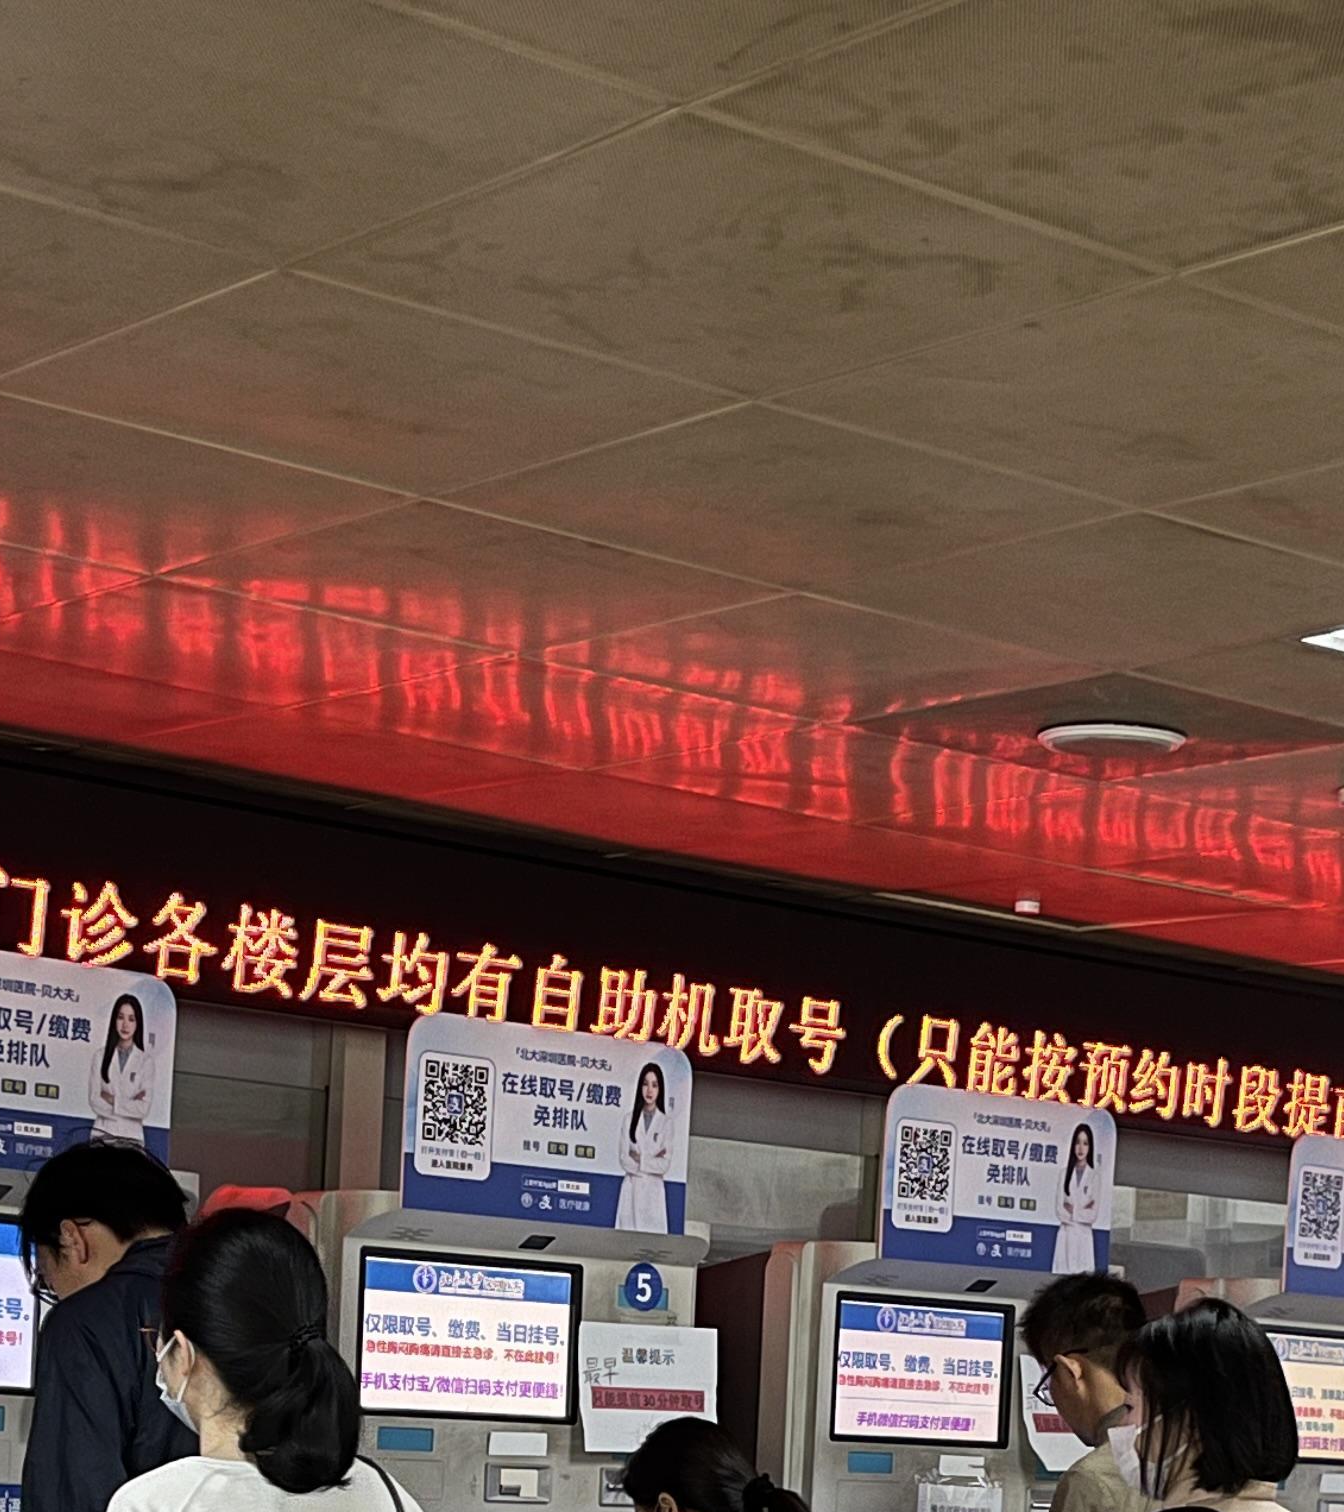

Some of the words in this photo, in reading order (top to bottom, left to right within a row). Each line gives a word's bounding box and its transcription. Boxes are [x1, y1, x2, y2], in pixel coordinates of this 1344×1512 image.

[501, 1072, 622, 1108] 在线取号/缴费
[533, 1104, 588, 1132] 免排队
[961, 1135, 1059, 1164] 在线取号/缴费
[986, 1163, 1030, 1187] 免排队
[635, 1272, 652, 1302] 5
